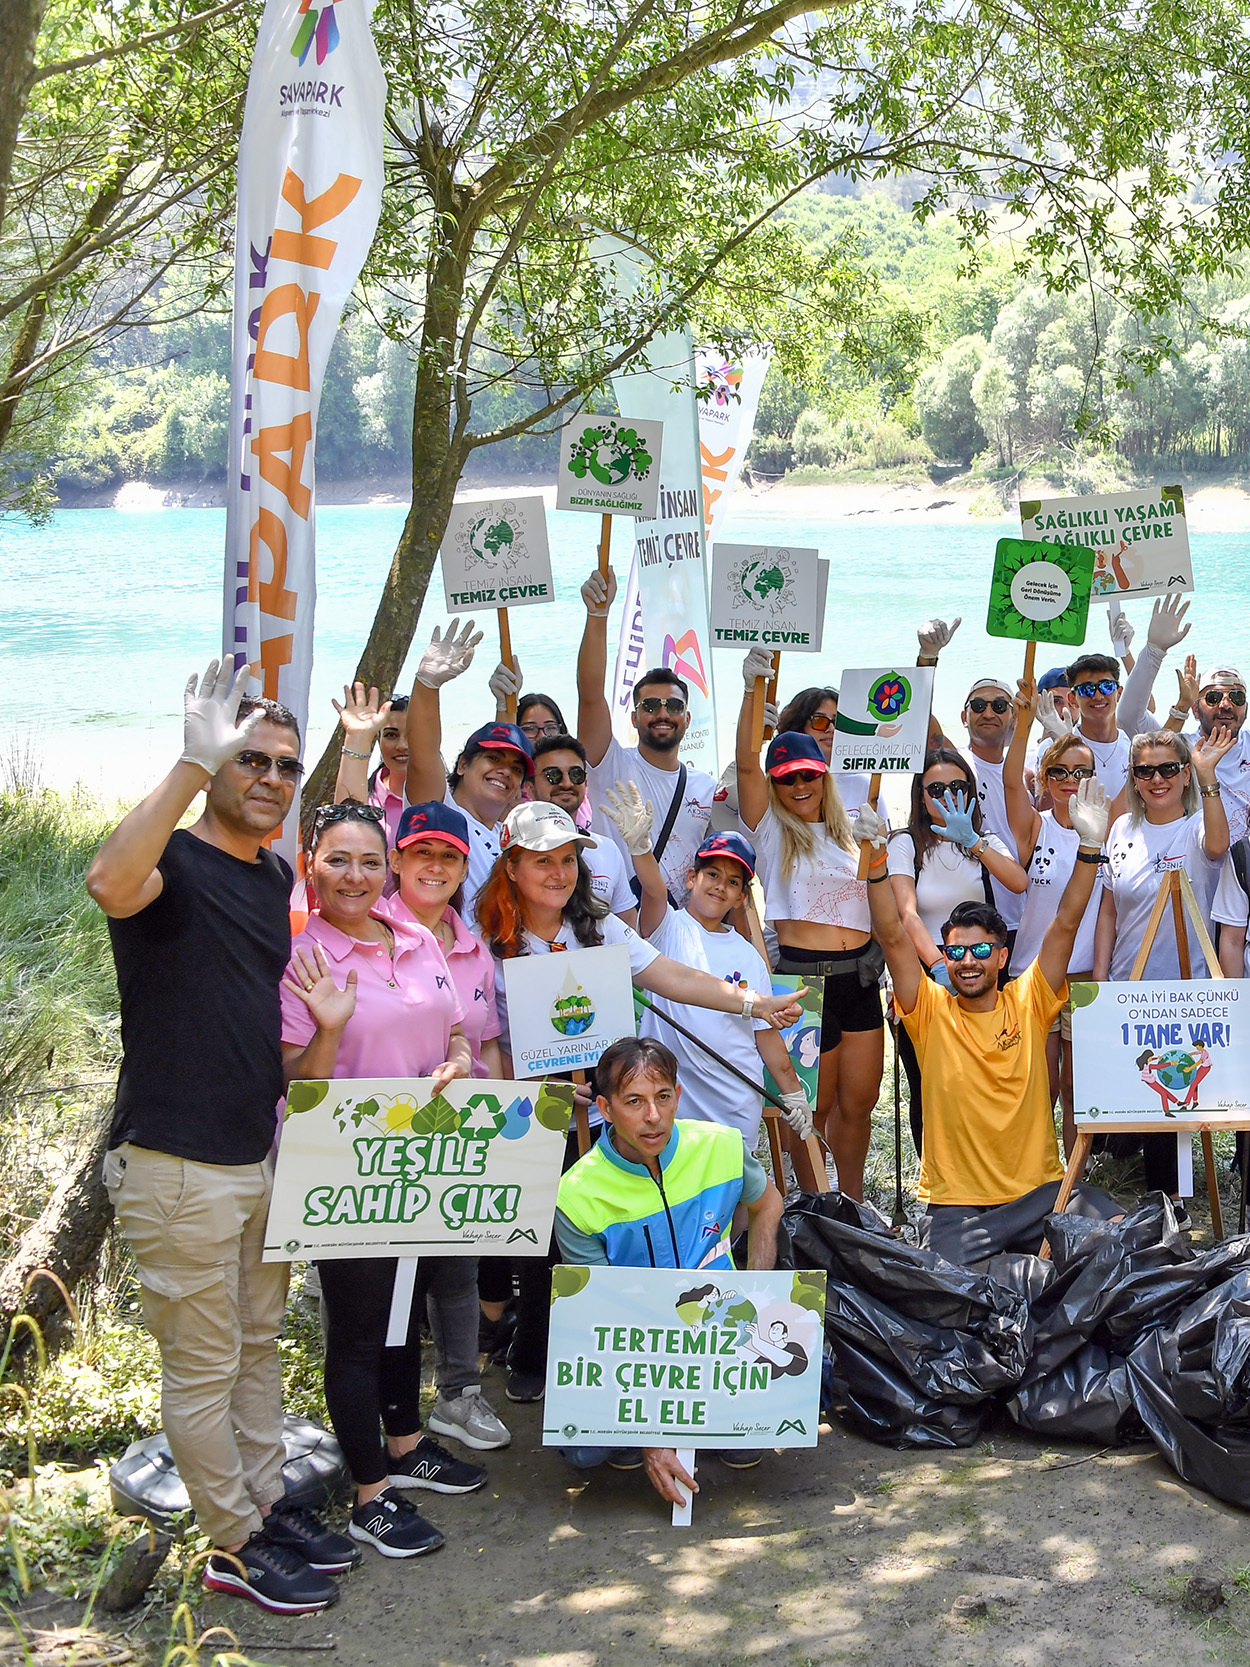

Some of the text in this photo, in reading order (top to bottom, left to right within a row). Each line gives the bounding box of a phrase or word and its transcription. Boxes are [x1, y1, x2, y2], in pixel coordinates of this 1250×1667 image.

[280, 81, 345, 107] SAYAPARK
[578, 488, 638, 501] DÜNYANIN SAĞLIĞI
[594, 498, 643, 511] SAĞLIĞIMIZ
[660, 484, 698, 519] İNSAN
[1034, 500, 1175, 531] SAĞLIKLI YAŞAM
[1122, 521, 1173, 546] ÇEVRE
[663, 531, 701, 569] ÇEVRE
[499, 583, 548, 602] ÇEVRE
[1026, 580, 1047, 588] Gelecek
[762, 630, 810, 644] ÇEVRE
[835, 742, 922, 757] GELECEĞİMİZ İÇİN
[842, 757, 911, 770] SIFIR ATIK
[1031, 877, 1051, 885] TUCK
[1117, 989, 1239, 1005] O'NA İYİ BAK ÇÜNKÜ
[1128, 1007, 1229, 1019] O'NDAN SADECE
[1121, 1022, 1230, 1049] 1 TANE VAR!
[520, 1048, 554, 1061] GÜZEL
[557, 1039, 608, 1056] YARINLAR
[528, 1053, 583, 1071] ÇEVRENE
[355, 1132, 488, 1180] YEŞİLE
[305, 1180, 520, 1228] SAHİP ÇIK!
[594, 1325, 738, 1355] TERTEMİZ
[557, 1356, 769, 1396] BİR ÇEVRE İÇİN
[618, 1398, 706, 1425] EL ELE
